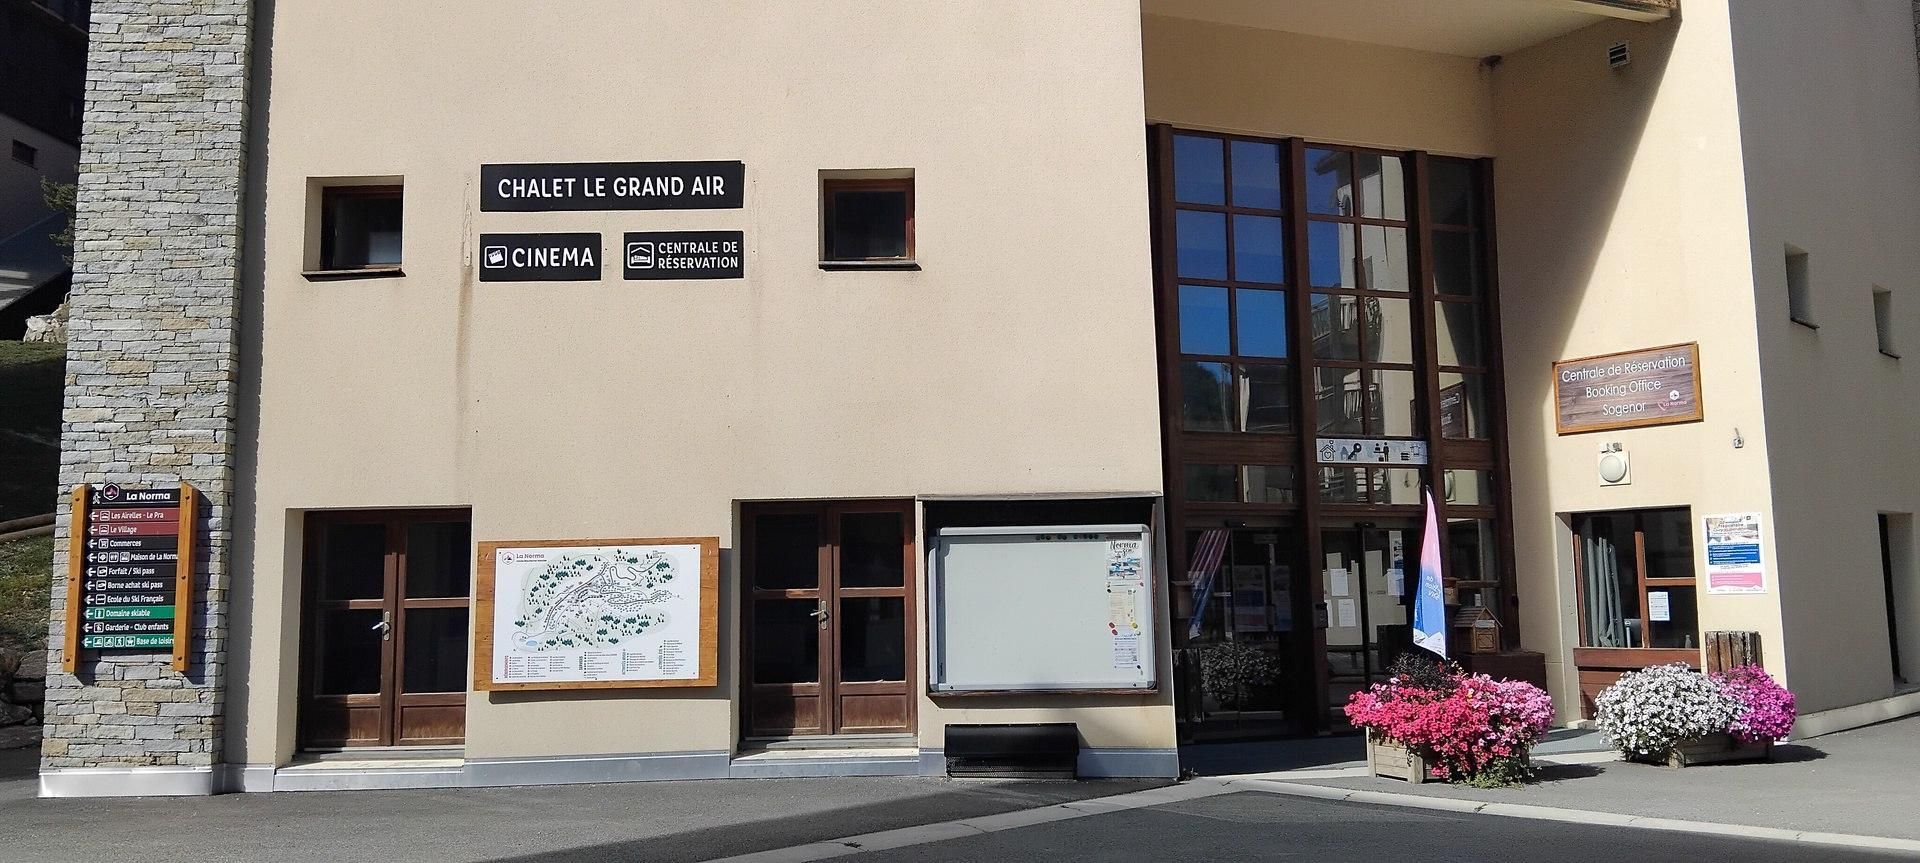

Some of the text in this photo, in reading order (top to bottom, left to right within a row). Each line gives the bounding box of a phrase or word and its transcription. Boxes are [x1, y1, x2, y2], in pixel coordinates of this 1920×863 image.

[498, 175, 725, 198] CHALET LE GRAND AIR
[658, 241, 738, 254] CENTRALE DE
[511, 247, 595, 268] CINEMA
[658, 255, 738, 269] RÉSERVATION
[1562, 356, 1686, 382] Centrale de Réservation
[1586, 380, 1662, 398] Booking Office
[1602, 402, 1646, 417] Sogenor
[139, 492, 170, 500] Norma
[118, 526, 137, 534] Village
[142, 568, 155, 576] pass
[150, 582, 163, 590] pass
[141, 594, 164, 604] Français
